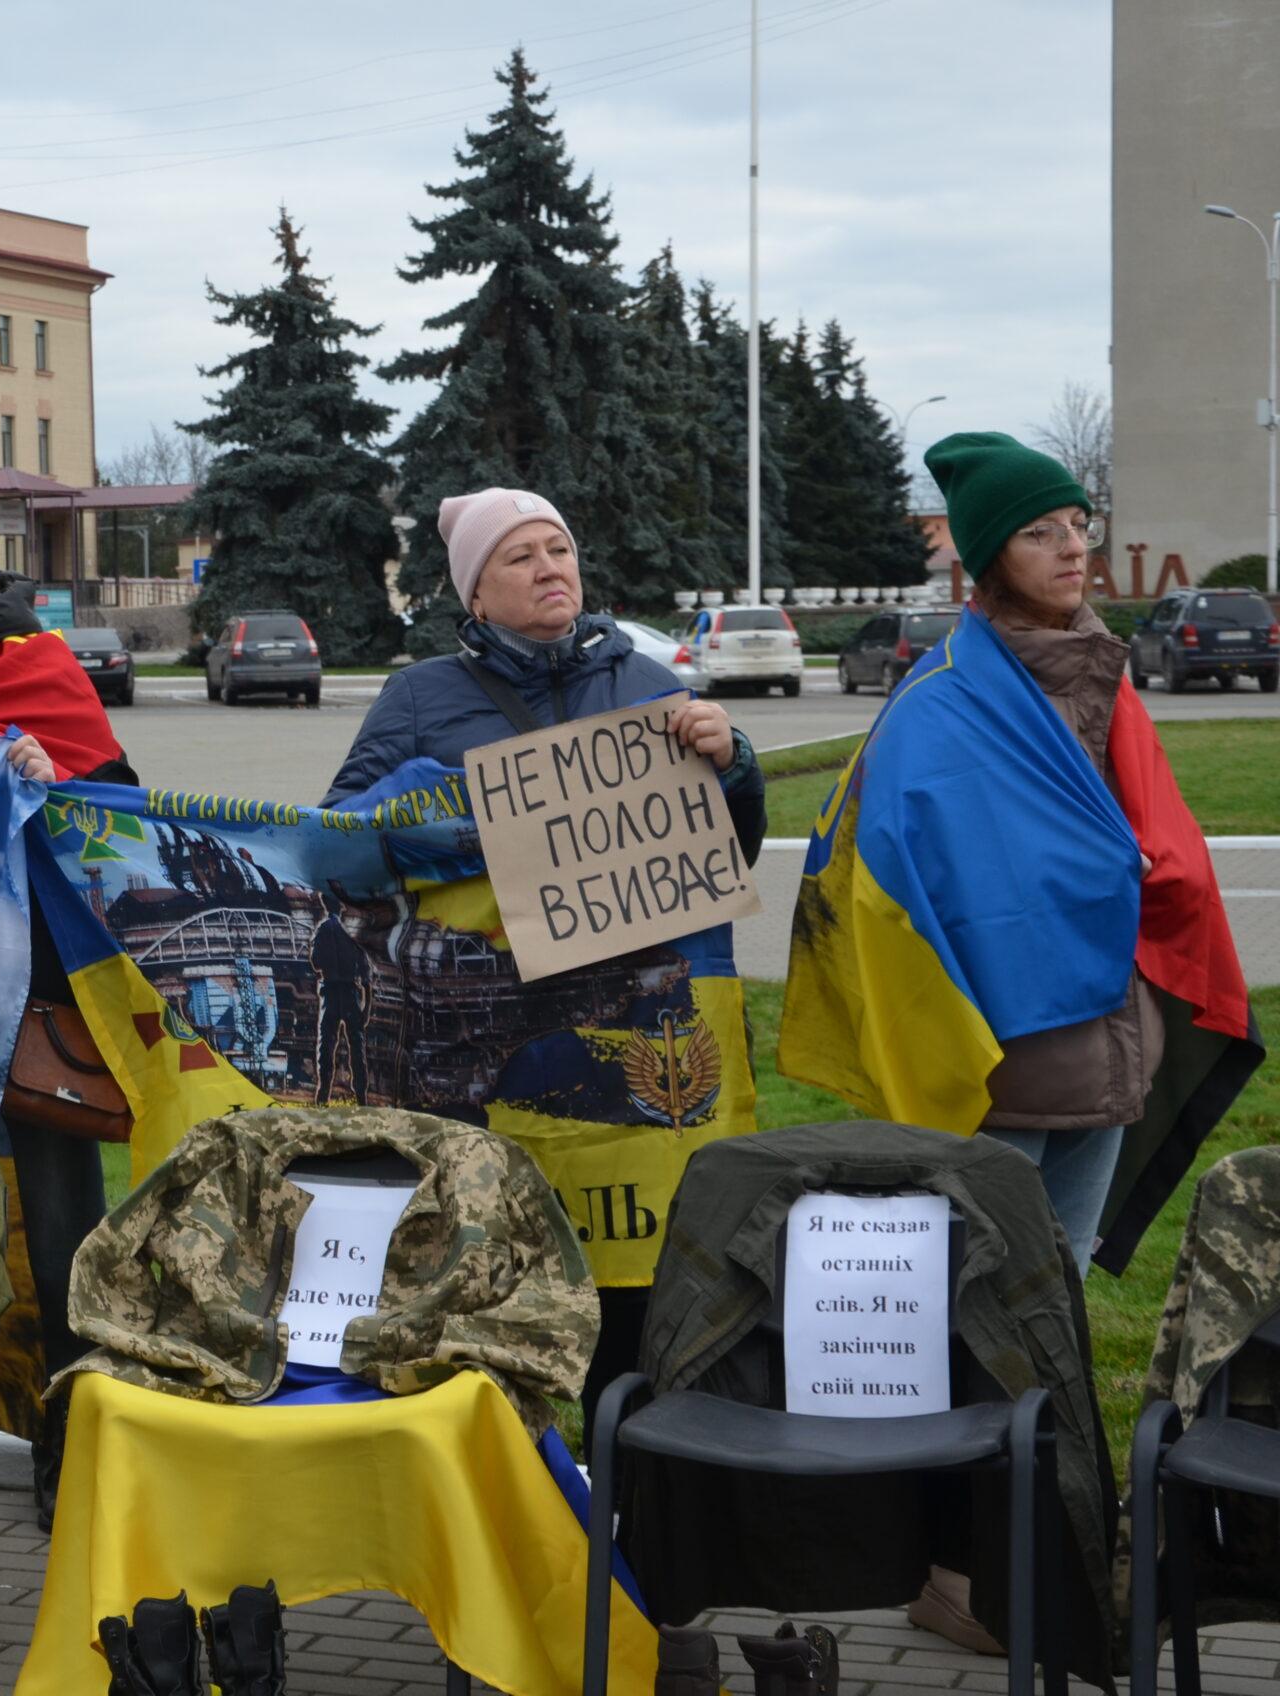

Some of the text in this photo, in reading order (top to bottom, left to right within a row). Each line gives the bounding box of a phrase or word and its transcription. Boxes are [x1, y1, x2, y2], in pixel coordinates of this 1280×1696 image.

[477, 748, 547, 823] НЕ
[371, 774, 470, 831] УКРАЇ
[544, 783, 715, 867] ПОЛОН
[539, 837, 747, 941] ВБИВАЄ!
[807, 1215, 930, 1233] Я не сказав
[321, 1239, 366, 1265] Я є,
[821, 1255, 913, 1272] останніх
[288, 1288, 329, 1305] але
[815, 1295, 919, 1313] слів. Я не
[309, 1331, 342, 1344] ви
[819, 1337, 916, 1355] закінчив
[811, 1377, 920, 1397] свій шлях
